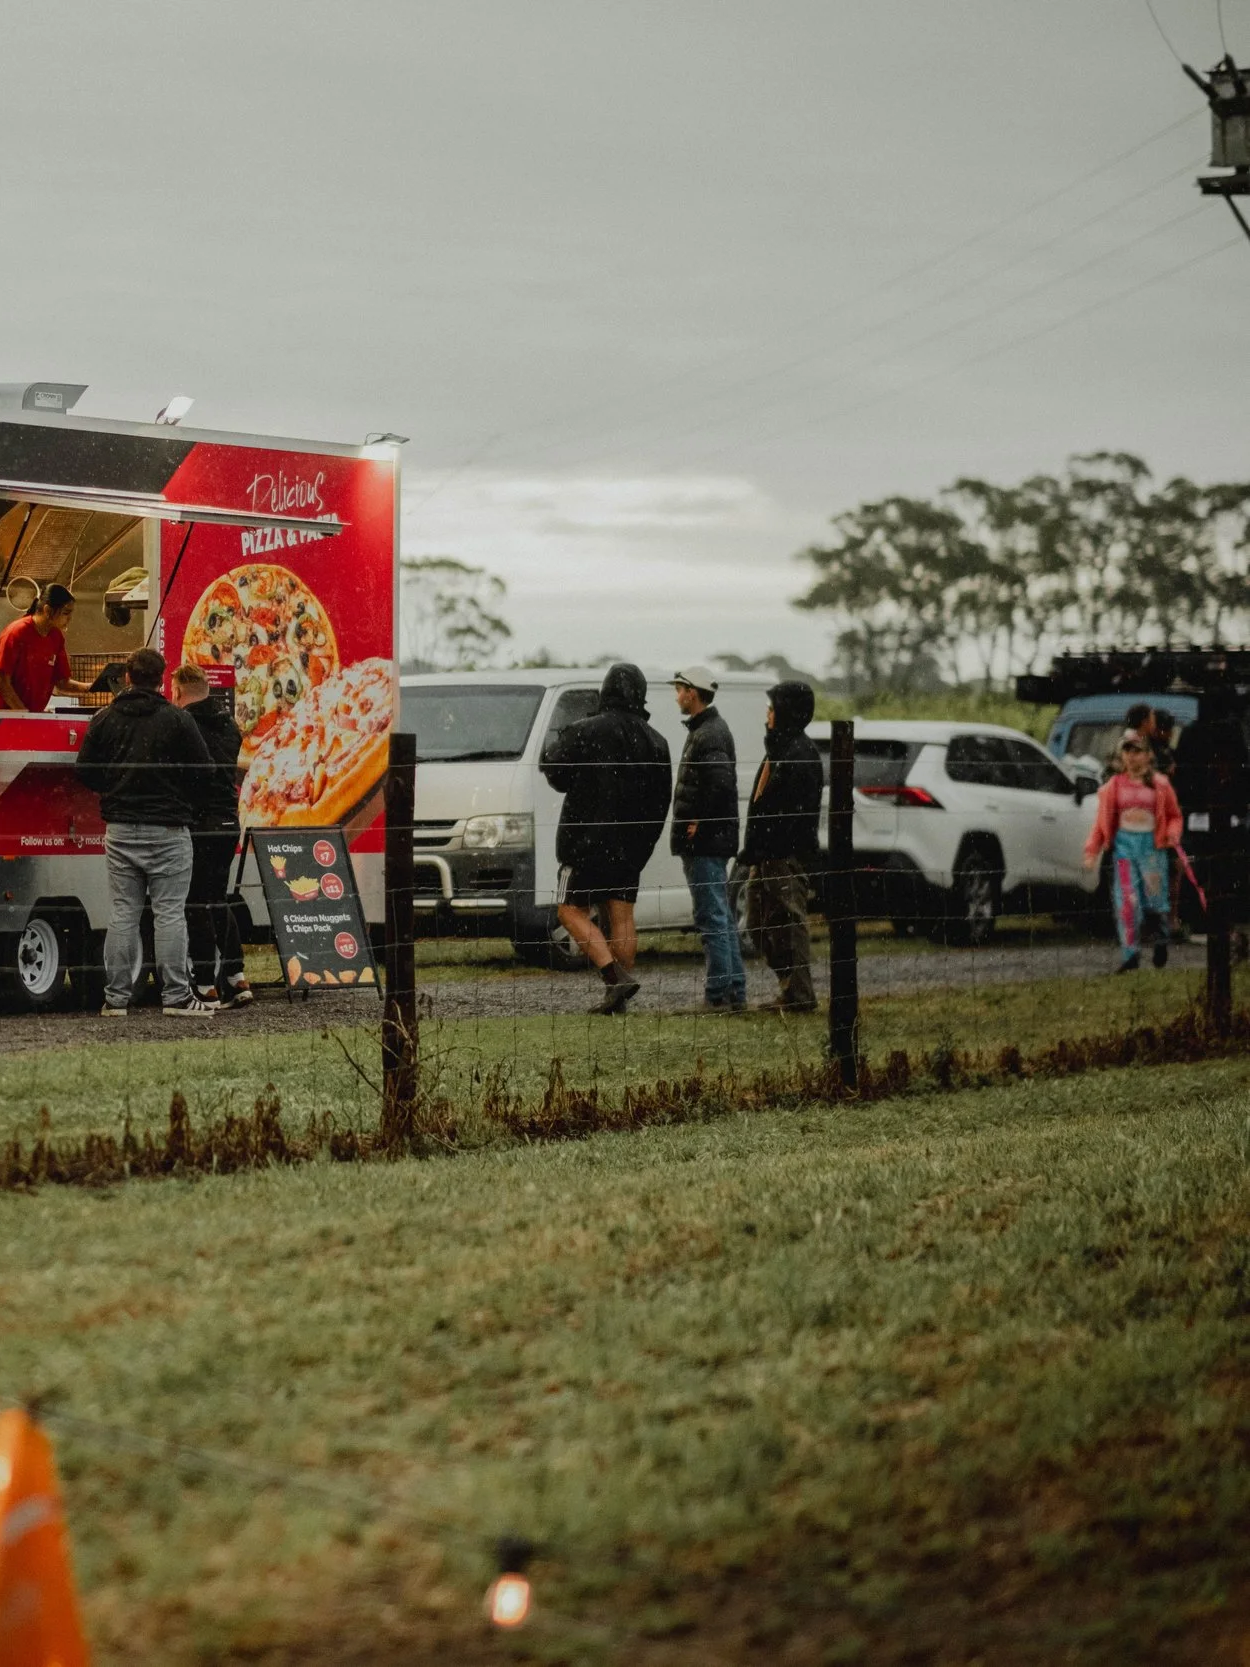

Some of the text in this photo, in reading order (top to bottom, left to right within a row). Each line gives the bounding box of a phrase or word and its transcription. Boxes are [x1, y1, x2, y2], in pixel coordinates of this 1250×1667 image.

[246, 470, 324, 513] Delicious
[241, 527, 285, 557] PIZZA
[20, 836, 43, 847] Follow
[44, 837, 53, 846] us
[267, 844, 303, 854] Hot Chips
[290, 914, 318, 923] Chicken
[319, 913, 351, 924] Nuggets
[293, 925, 313, 934] Chips
[313, 924, 332, 932] Pack
